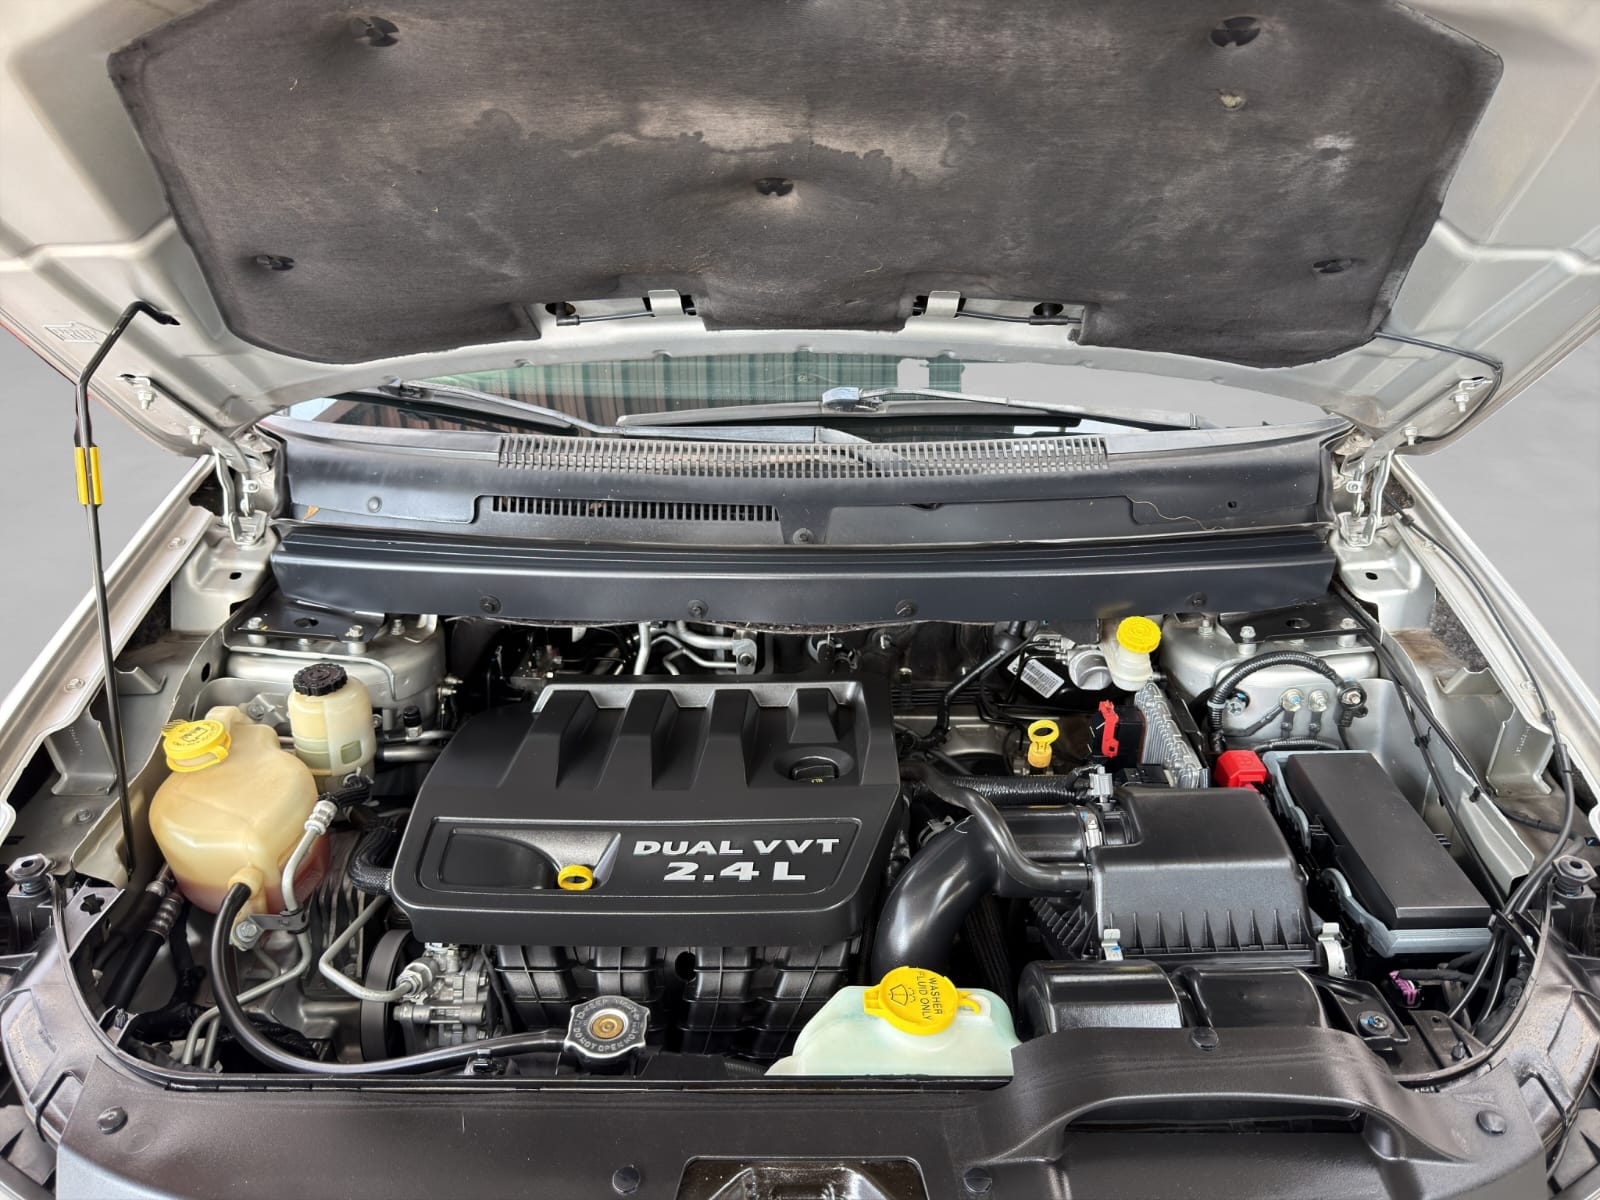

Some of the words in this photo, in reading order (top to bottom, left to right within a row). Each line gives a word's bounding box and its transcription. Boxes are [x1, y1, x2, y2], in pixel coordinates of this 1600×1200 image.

[633, 840, 743, 855] DUAL
[753, 838, 840, 855] VVT
[929, 977, 943, 1015] WASHER
[919, 998, 933, 1021] ONLY
